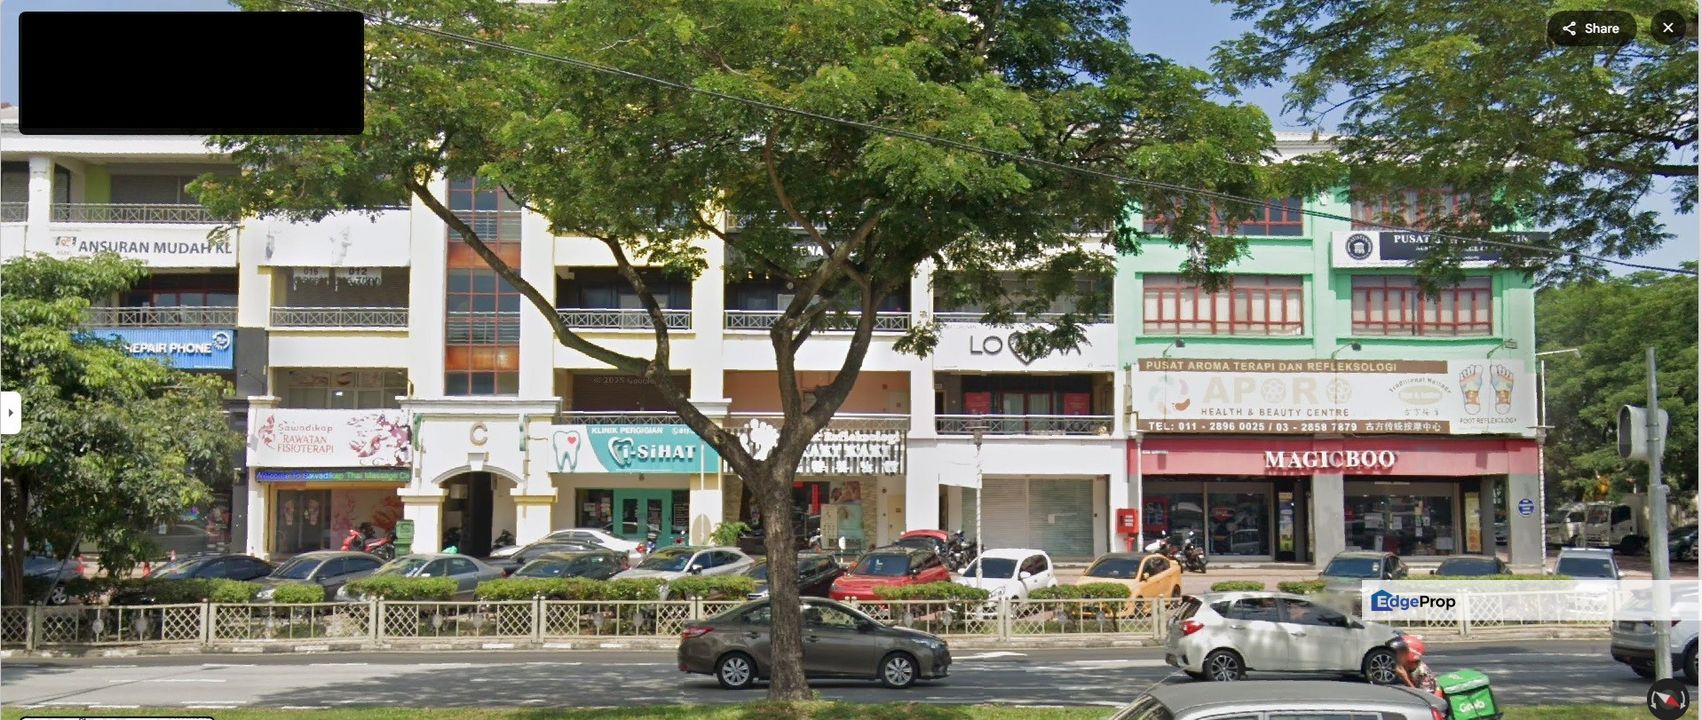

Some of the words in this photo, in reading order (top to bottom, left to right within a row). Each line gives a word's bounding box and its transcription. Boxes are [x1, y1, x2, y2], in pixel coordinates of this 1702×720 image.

[1393, 234, 1430, 245] PUSAT
[78, 240, 149, 253] ANSURAN
[153, 241, 211, 254] MUDAH
[215, 242, 232, 254] KL
[171, 343, 212, 354] PHONE
[1145, 361, 1184, 370] PUSAT
[1187, 361, 1230, 370] AROMA
[1233, 361, 1275, 371] TERAPI
[1278, 362, 1303, 371] DAN
[1307, 362, 1397, 371] REFLEKSOLOGI
[1201, 408, 1243, 416] HEALTH
[1247, 408, 1254, 416] &
[1259, 408, 1301, 416] BEAUTY
[1307, 408, 1349, 417] CENTRE
[278, 424, 333, 434] Sawadikap
[620, 427, 664, 435] PERGIGIAN
[1148, 421, 1174, 431] TEL:
[1178, 421, 1197, 431] 011
[1209, 421, 1235, 431] 2896
[1239, 421, 1265, 431] 0025
[1276, 422, 1289, 431] 03
[1301, 422, 1327, 432] 2858
[1330, 422, 1357, 432] 7879
[283, 435, 327, 443] RAWATAN
[470, 422, 488, 446] C
[277, 444, 334, 454] FISIOTERAPI
[623, 445, 696, 460] i-SiHAT
[1264, 450, 1395, 468] MAGICBOO
